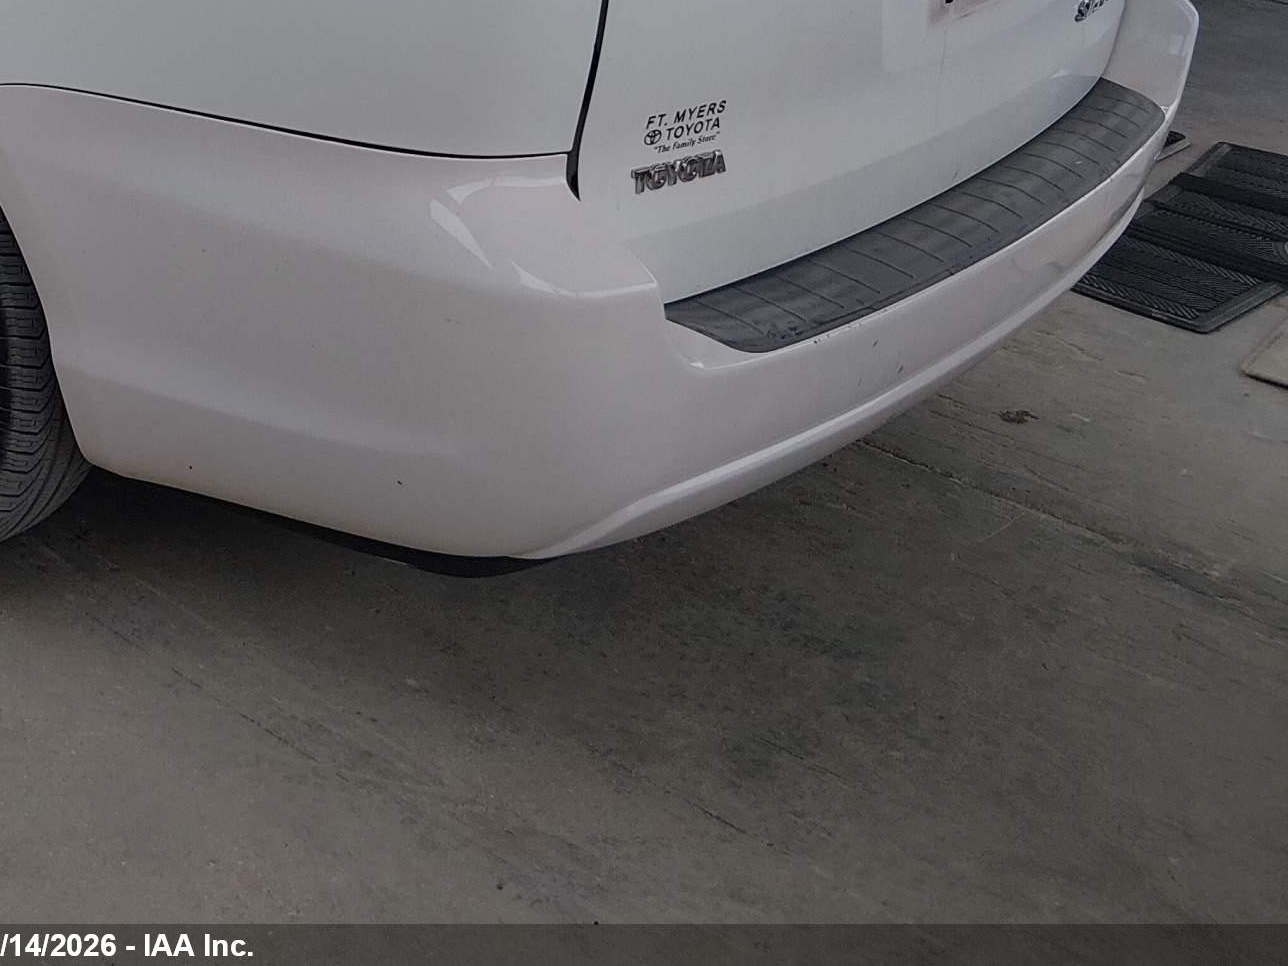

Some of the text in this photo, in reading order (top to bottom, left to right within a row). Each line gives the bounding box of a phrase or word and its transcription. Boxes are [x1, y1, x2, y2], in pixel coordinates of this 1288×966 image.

[645, 99, 727, 130] FT. MYERS
[666, 116, 721, 141] TOYOTA
[631, 149, 727, 195] TOYOTA
